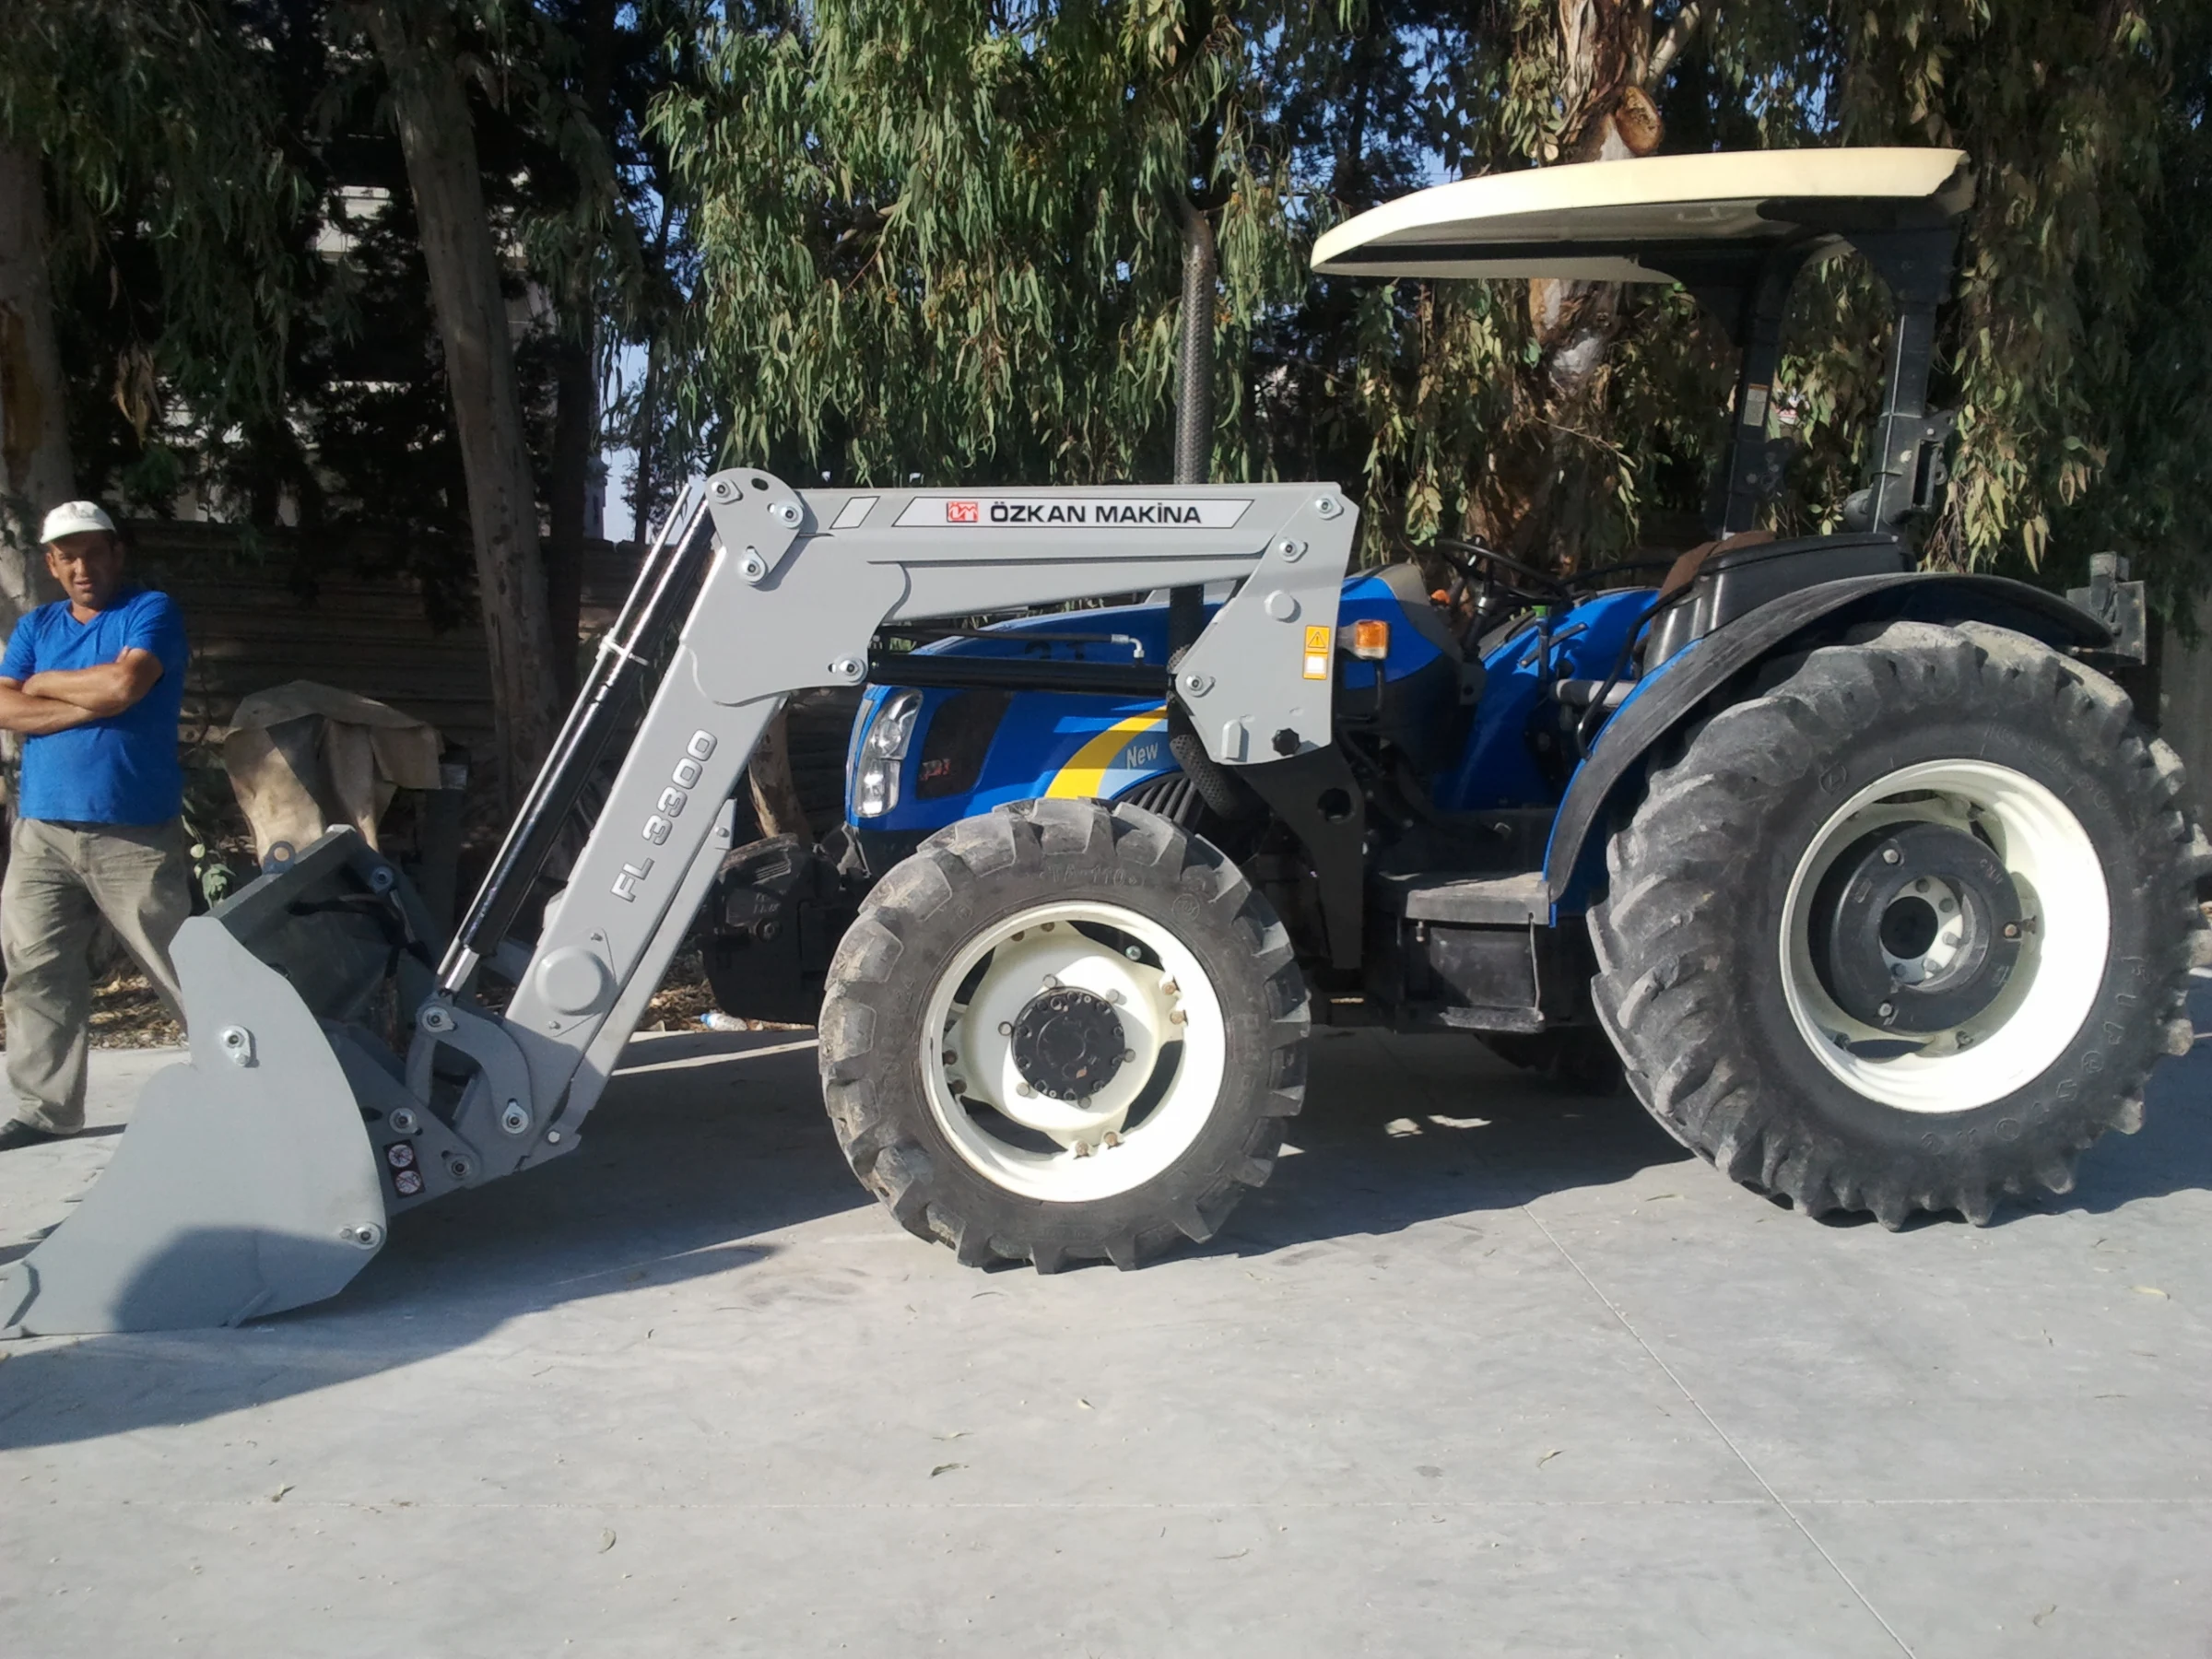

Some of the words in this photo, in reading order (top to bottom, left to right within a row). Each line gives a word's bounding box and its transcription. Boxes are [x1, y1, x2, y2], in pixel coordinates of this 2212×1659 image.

[990, 500, 1086, 524] ÖZKAN
[1095, 502, 1202, 524] MAKİNA
[1125, 742, 1159, 771] New
[610, 857, 655, 903] FL
[641, 728, 718, 846] 3300
